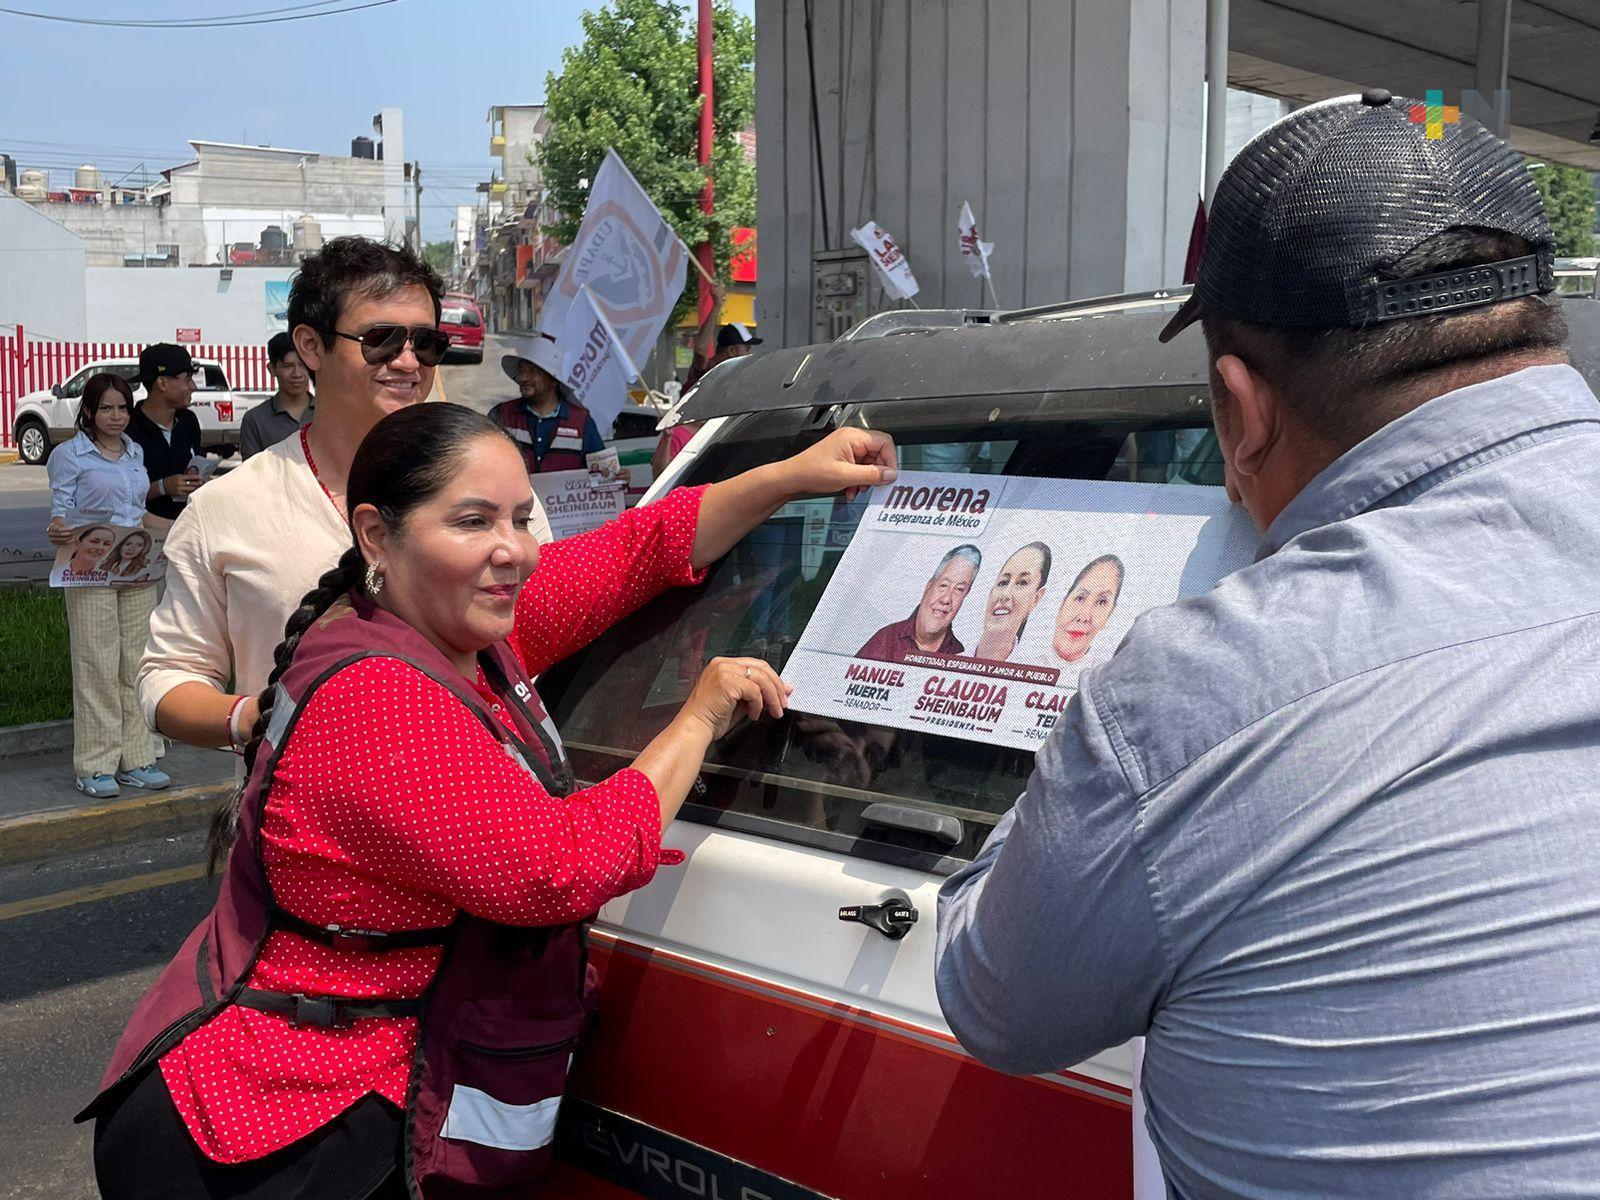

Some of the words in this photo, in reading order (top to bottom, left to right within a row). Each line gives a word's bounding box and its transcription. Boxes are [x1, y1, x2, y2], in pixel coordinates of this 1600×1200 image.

[545, 491, 615, 506] CLAUDIA
[884, 485, 990, 514] morena
[546, 501, 617, 515] SHEINBAUM
[877, 510, 887, 522] La
[889, 514, 931, 526] esperanza
[933, 513, 944, 526] de
[946, 514, 981, 528] México
[62, 569, 109, 577] CLAUDIA
[845, 664, 905, 688] MANUEL
[993, 667, 1014, 677] AMOR
[1026, 671, 1054, 682] PUEBLO
[845, 683, 890, 701] HUERTA
[923, 675, 1008, 707] CLAUDIA
[844, 698, 881, 711] SENADOR
[914, 696, 1002, 723] SHEINBAUM
[925, 715, 975, 732] PRESIDENTA
